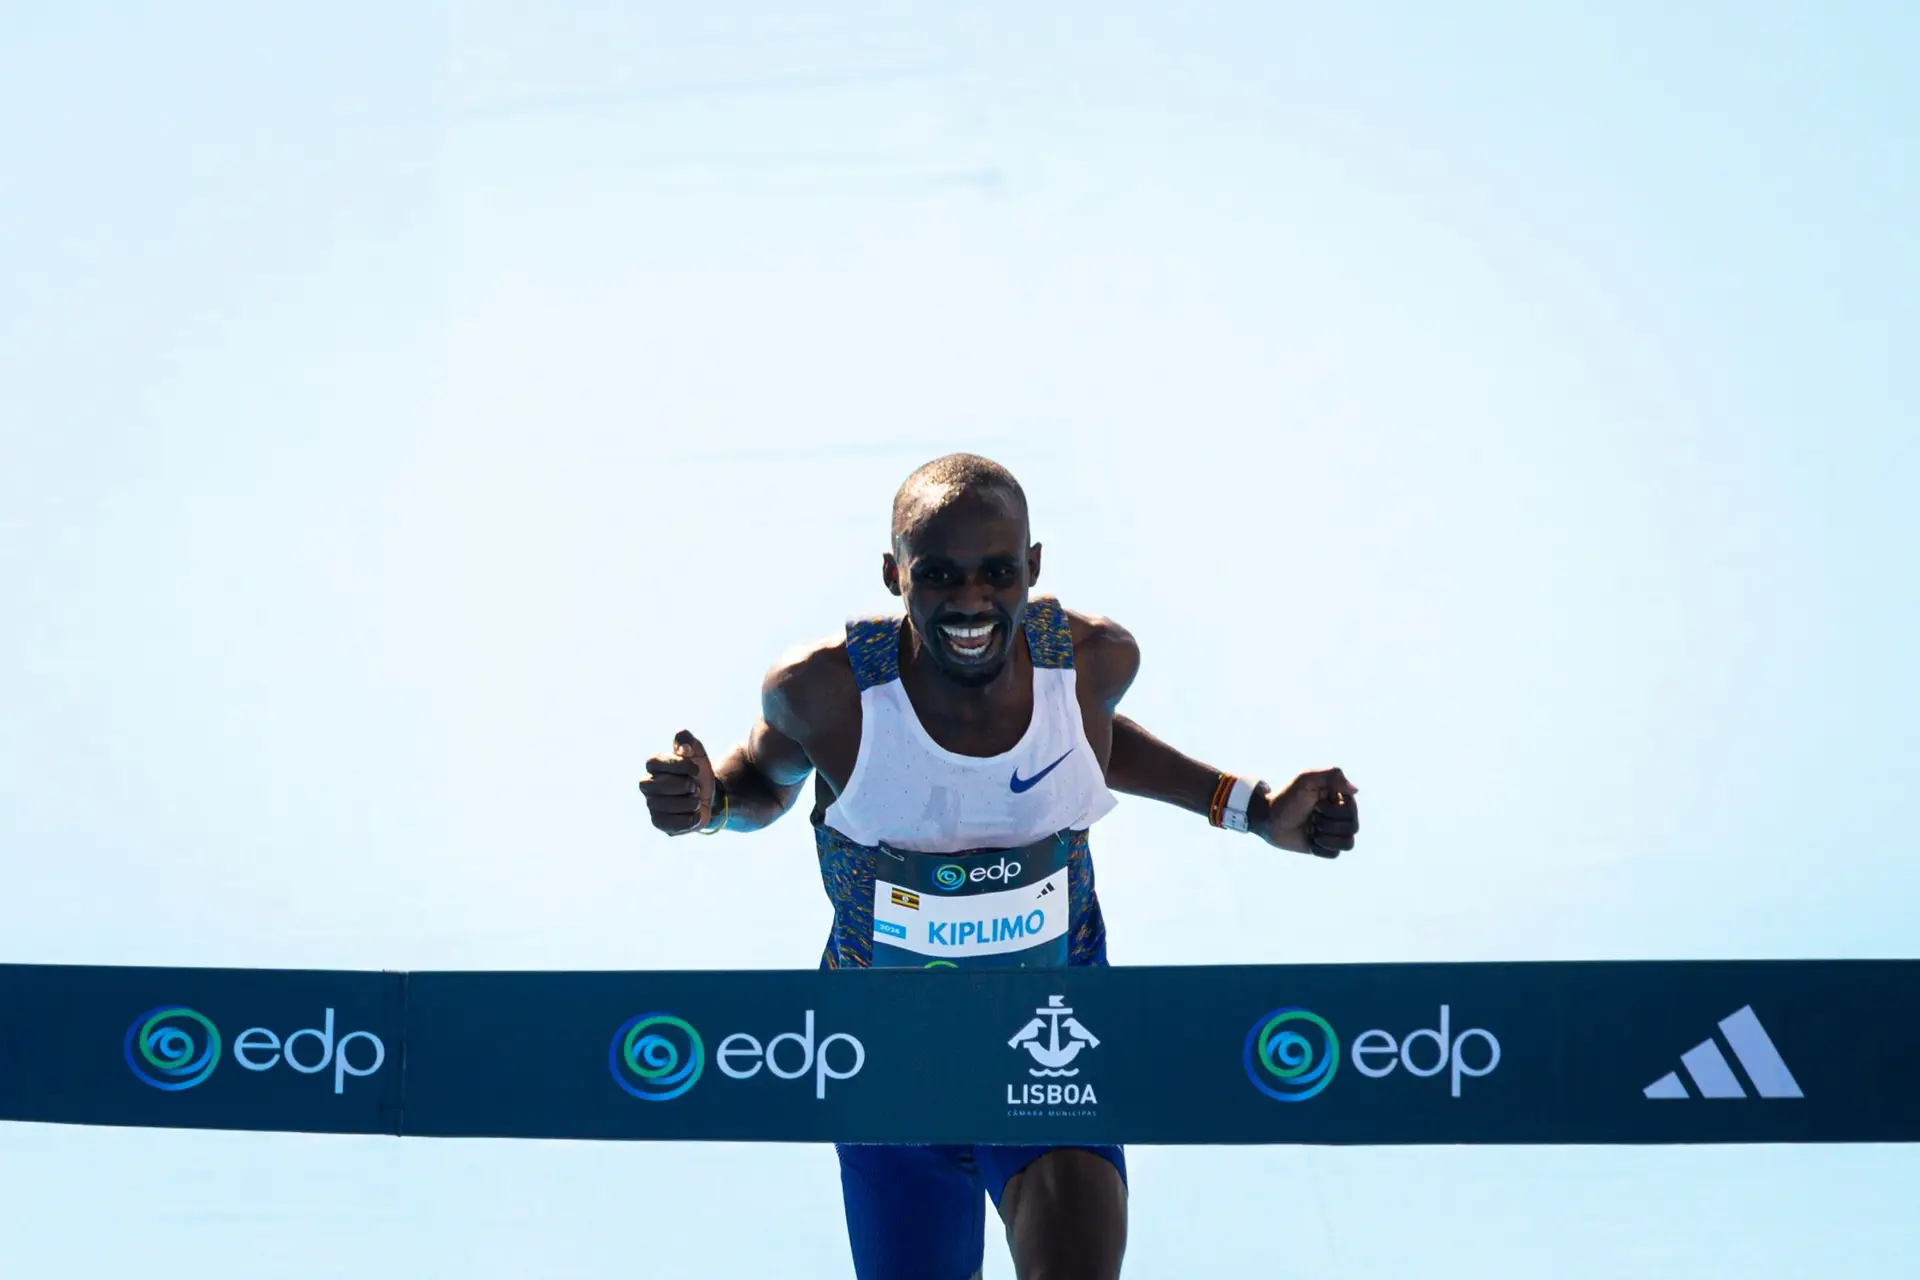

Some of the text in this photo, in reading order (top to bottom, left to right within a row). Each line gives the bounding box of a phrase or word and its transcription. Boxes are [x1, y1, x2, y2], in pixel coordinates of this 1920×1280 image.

[969, 857, 1022, 884] edp
[928, 909, 1045, 946] KIPLIMO
[233, 1007, 385, 1094] edp
[716, 1009, 866, 1099] edp
[1351, 1004, 1501, 1097] edp
[1007, 1083, 1098, 1105] LISBOA
